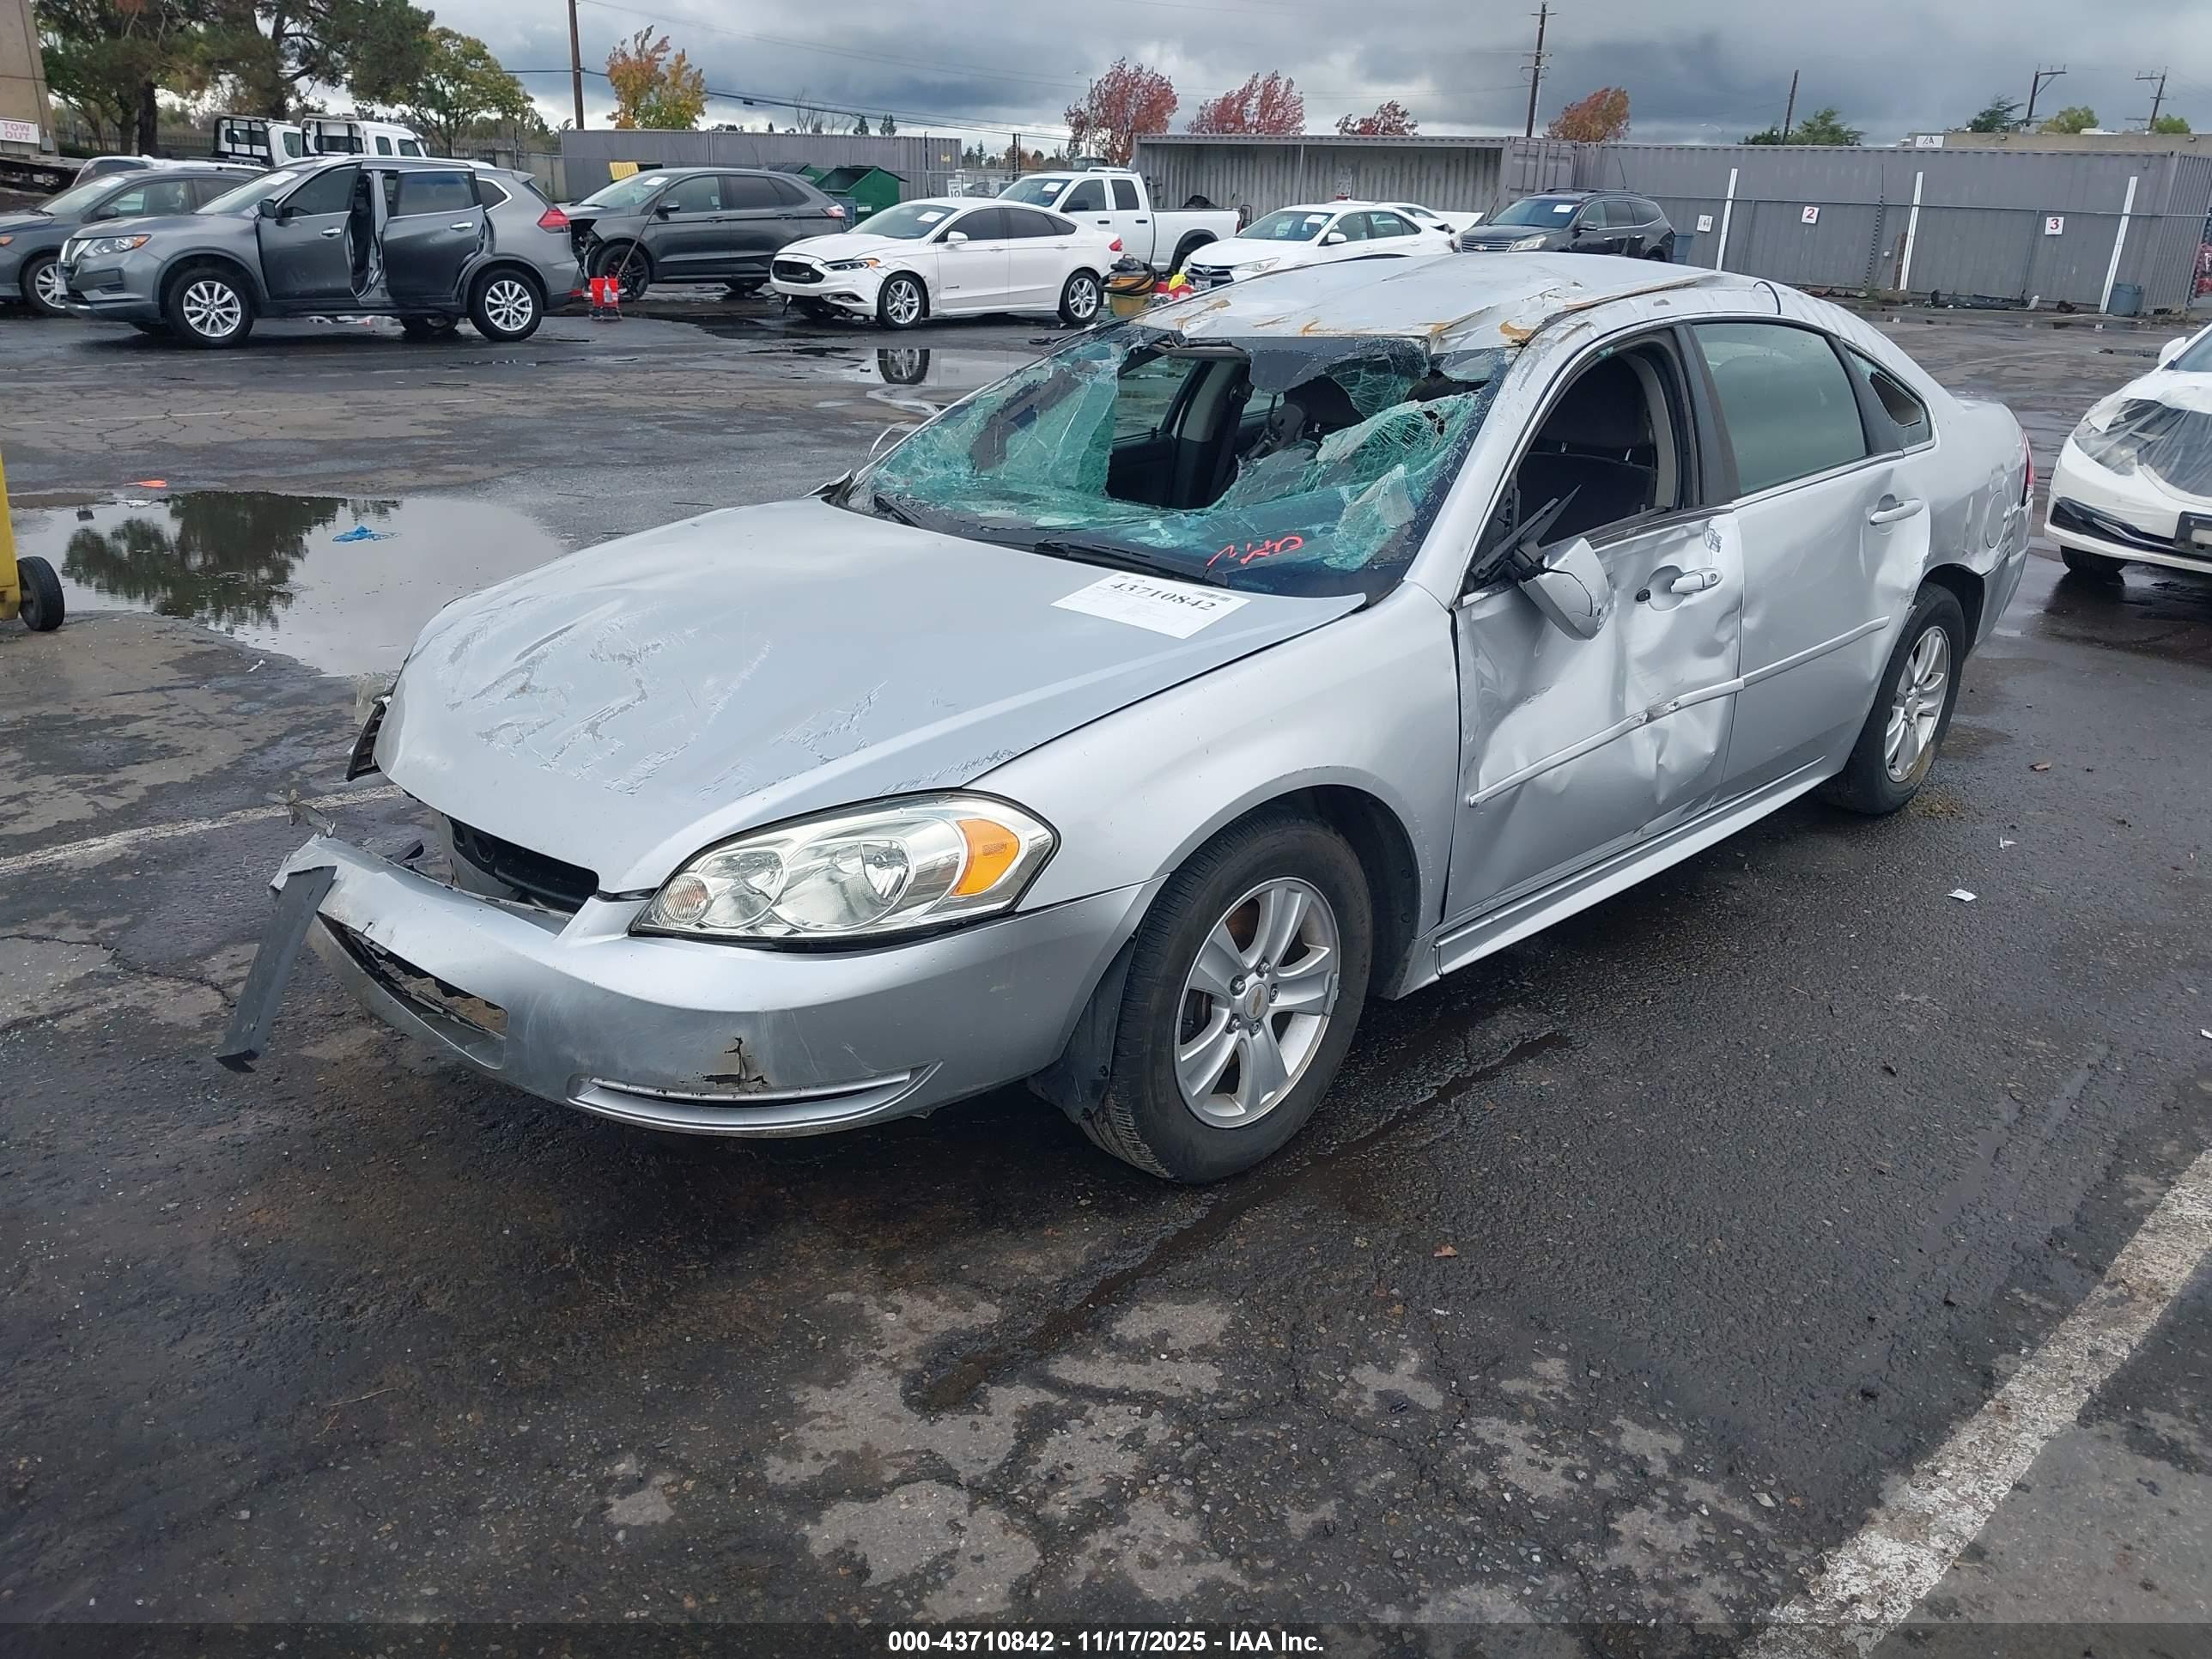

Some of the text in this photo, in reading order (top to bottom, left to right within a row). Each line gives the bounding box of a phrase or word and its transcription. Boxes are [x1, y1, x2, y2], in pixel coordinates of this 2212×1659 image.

[3, 122, 30, 132] TOW
[5, 131, 30, 140] OUT
[1806, 208, 1815, 220] 2
[2050, 218, 2060, 230] 3
[1109, 581, 1218, 611] 43710842
